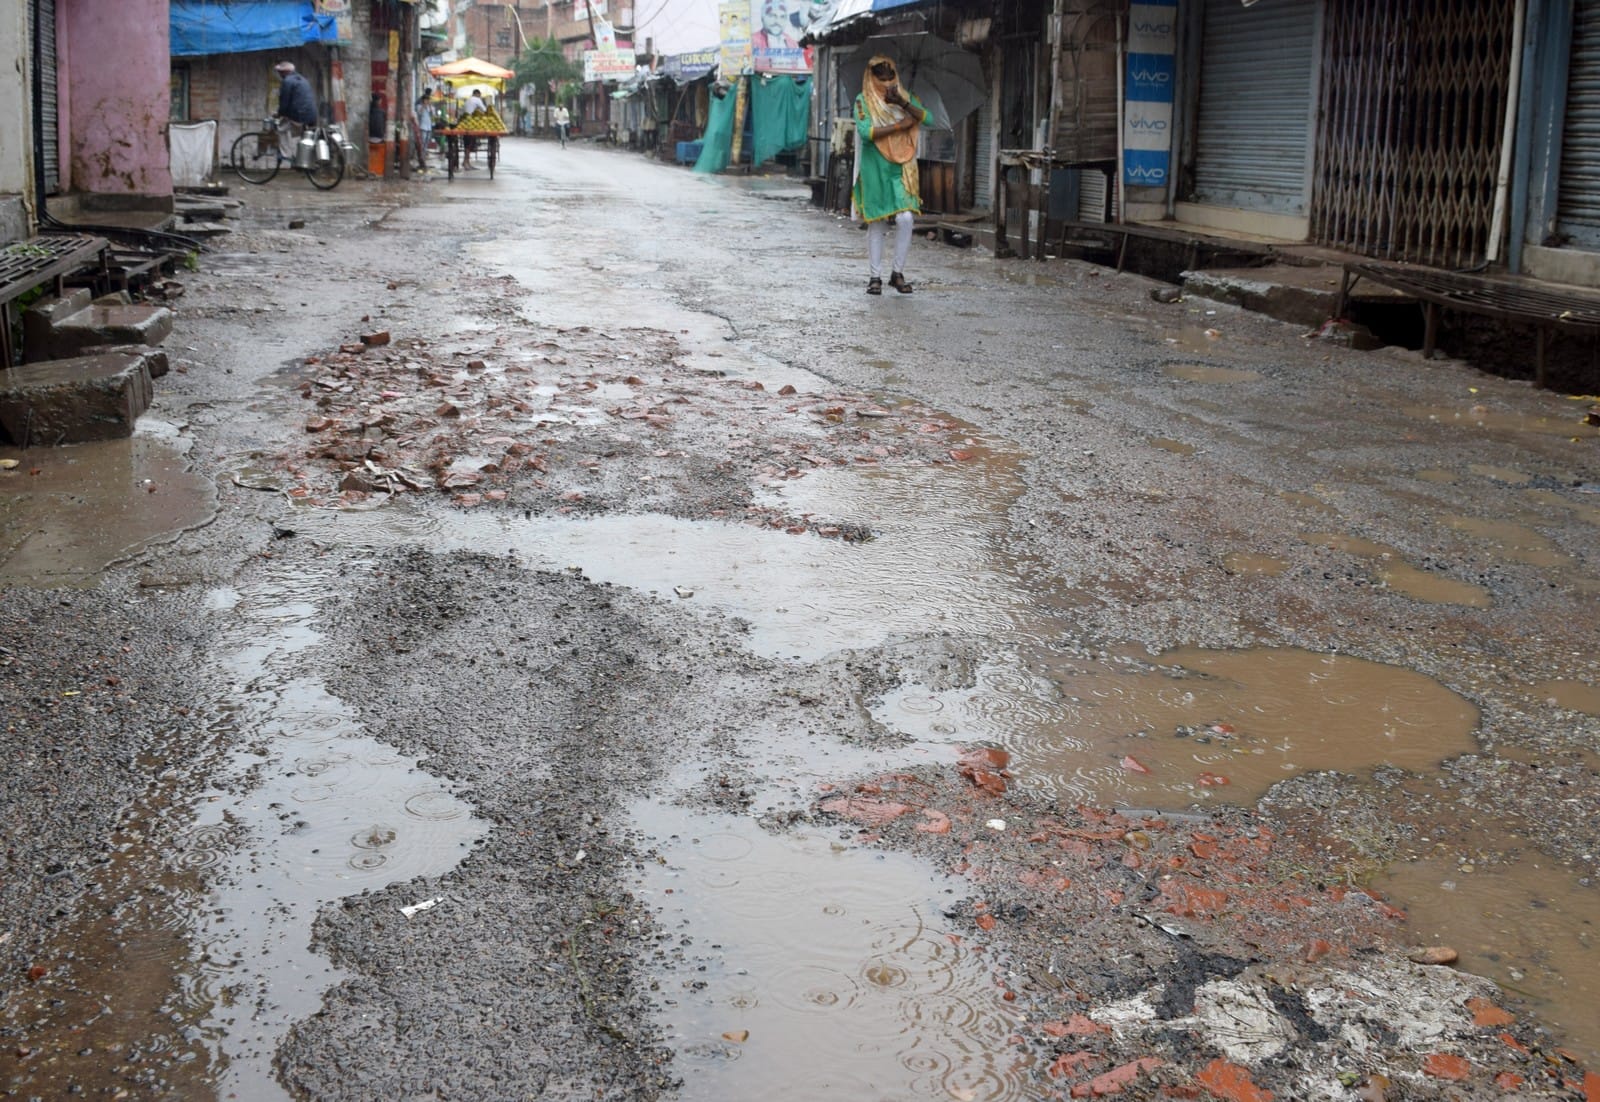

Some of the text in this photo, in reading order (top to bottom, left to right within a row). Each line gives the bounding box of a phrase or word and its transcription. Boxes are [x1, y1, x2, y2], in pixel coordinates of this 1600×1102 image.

[1131, 70, 1169, 82] vivo
[1129, 117, 1167, 129] vivo
[1127, 165, 1164, 178] vivo
